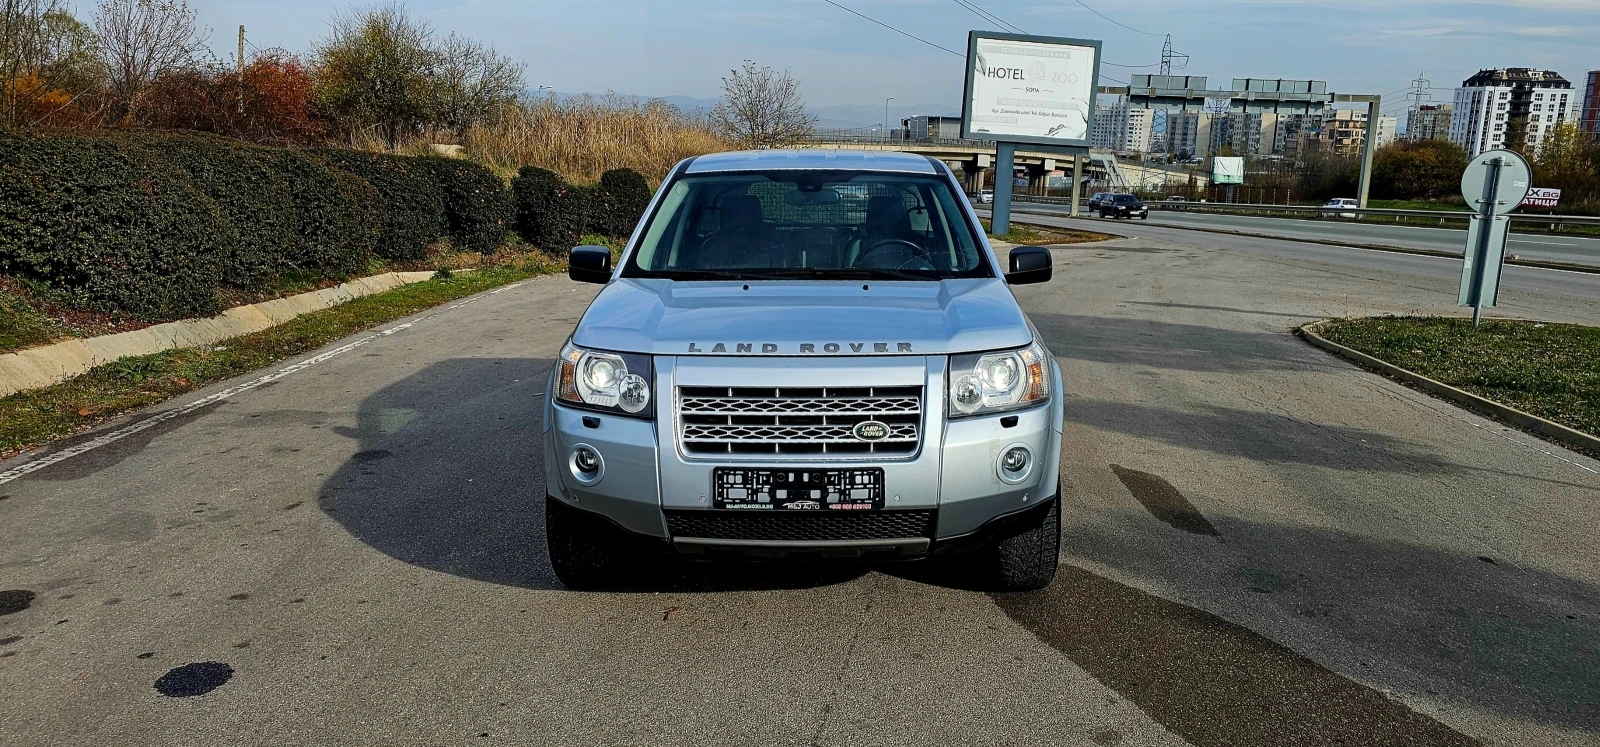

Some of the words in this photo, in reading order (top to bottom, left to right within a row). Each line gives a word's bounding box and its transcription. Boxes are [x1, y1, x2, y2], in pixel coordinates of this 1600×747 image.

[988, 67, 1025, 80] HOTEL
[1051, 72, 1078, 84] ZOO
[688, 342, 778, 353] LAND
[799, 342, 913, 353] ROVER
